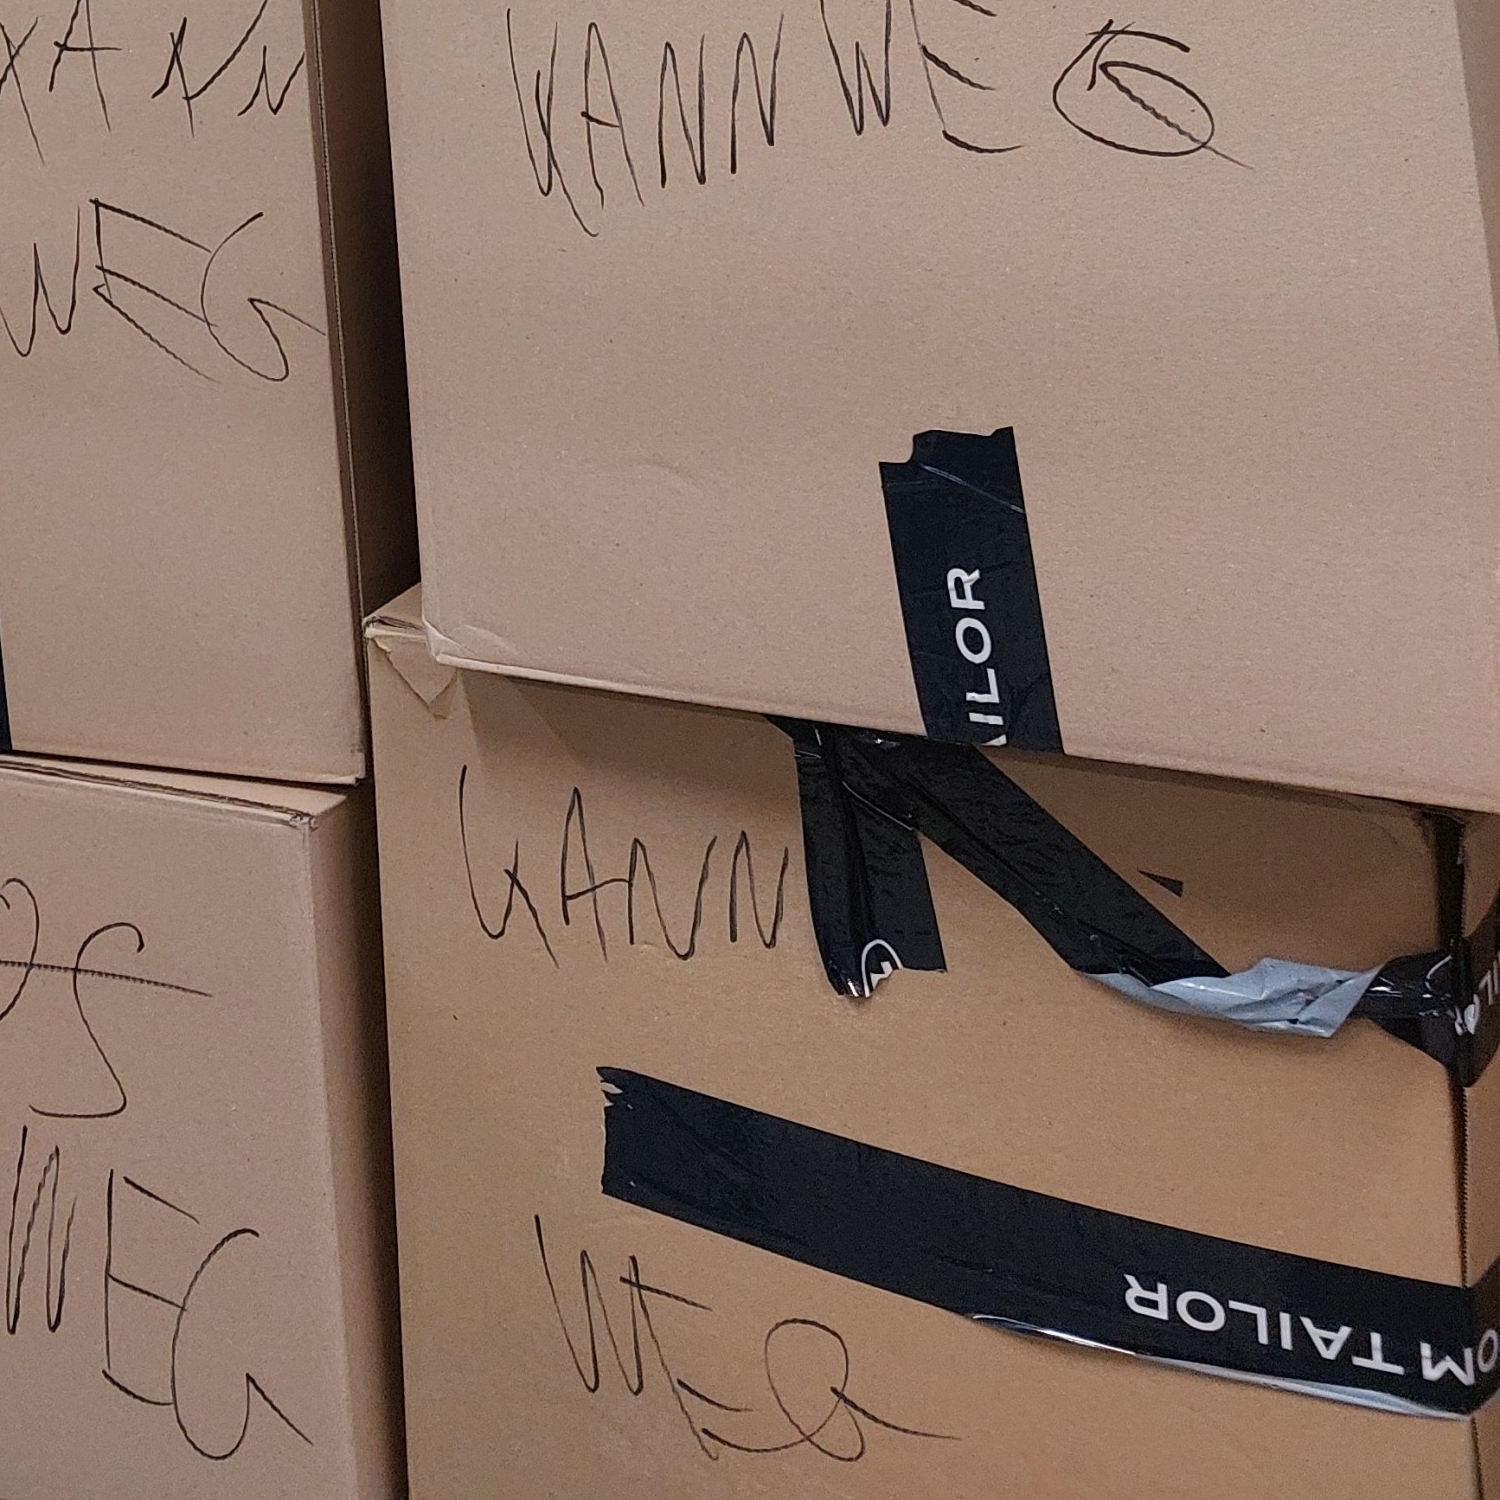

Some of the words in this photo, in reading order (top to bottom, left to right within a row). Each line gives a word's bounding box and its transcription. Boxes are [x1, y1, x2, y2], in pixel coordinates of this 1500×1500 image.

[507, 8, 784, 237] KANN
[5, 1125, 314, 1460] WEG
[1123, 1273, 1405, 1375] TAILOR
[1419, 1328, 1500, 1387] OM
